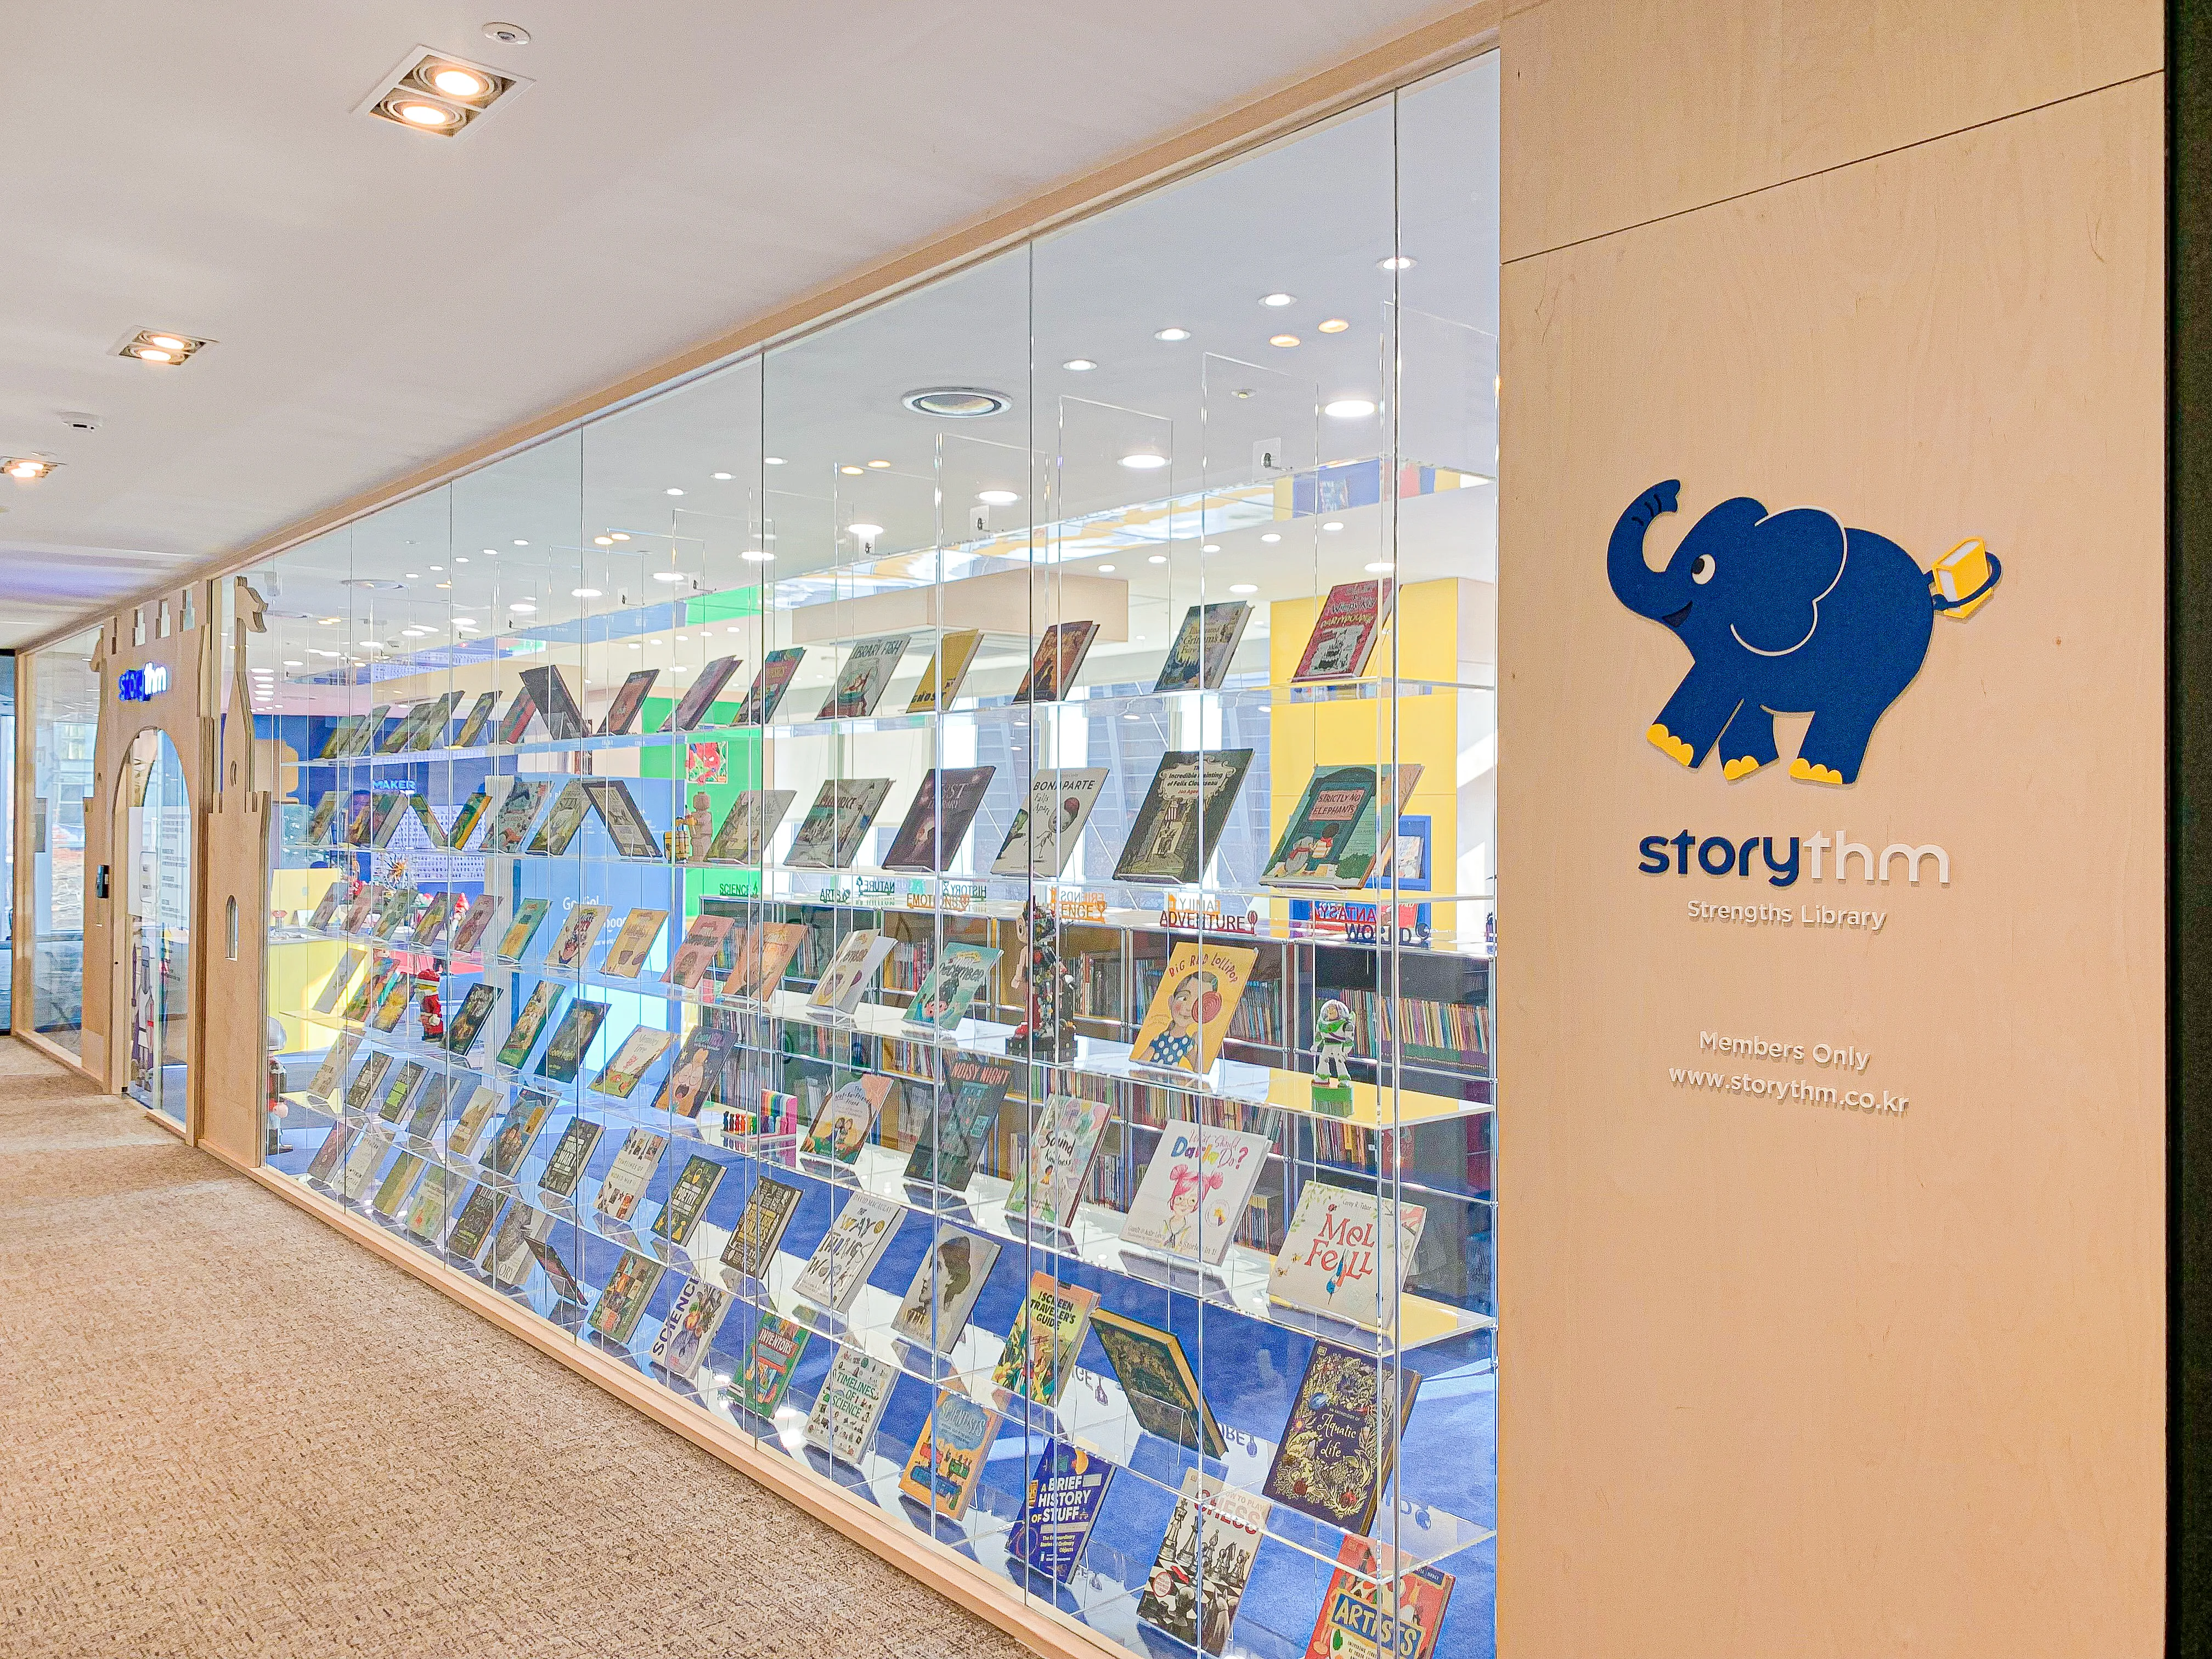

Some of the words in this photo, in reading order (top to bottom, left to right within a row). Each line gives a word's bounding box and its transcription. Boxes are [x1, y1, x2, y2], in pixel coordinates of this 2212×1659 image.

[373, 780, 416, 790] MAKER
[1035, 792, 1049, 803] Falls
[1318, 794, 1350, 802] STRICTLY
[1350, 793, 1361, 802] NO
[1313, 804, 1355, 815] ELEPHANTS
[1638, 830, 1950, 887] storythm
[720, 883, 750, 896] SCIENCE
[1160, 910, 1245, 930] ADVENTURE
[1687, 900, 1793, 924] Strengths
[1801, 904, 1887, 931] Library
[1700, 1030, 1804, 1060] Members
[1812, 1043, 1870, 1071] Only
[1668, 1065, 1910, 1113] www.storythm.co.kr
[1040, 1130, 1076, 1157] Sound
[1171, 1136, 1220, 1165] Darla
[1217, 1147, 1249, 1170] Do?
[1183, 1242, 1201, 1252] Storie
[1030, 1299, 1076, 1324] TRAVEER'S
[1036, 1313, 1062, 1330] GUIDE
[758, 1328, 793, 1355] INVENTORS
[837, 1372, 875, 1398] TIMELINES
[845, 1390, 857, 1401] OF
[832, 1395, 862, 1419] SCIENCE
[1317, 1413, 1357, 1438] Aquatic
[1321, 1440, 1341, 1458] Life
[1041, 1483, 1047, 1492] A
[1048, 1475, 1082, 1492] BRIEF
[1038, 1489, 1092, 1508] HISTORY
[1237, 1493, 1246, 1504] TO
[1031, 1514, 1042, 1523] OF
[1042, 1506, 1080, 1523] STUFF
[1194, 1489, 1261, 1534] CHESS
[1334, 1597, 1417, 1656] ARTISS
